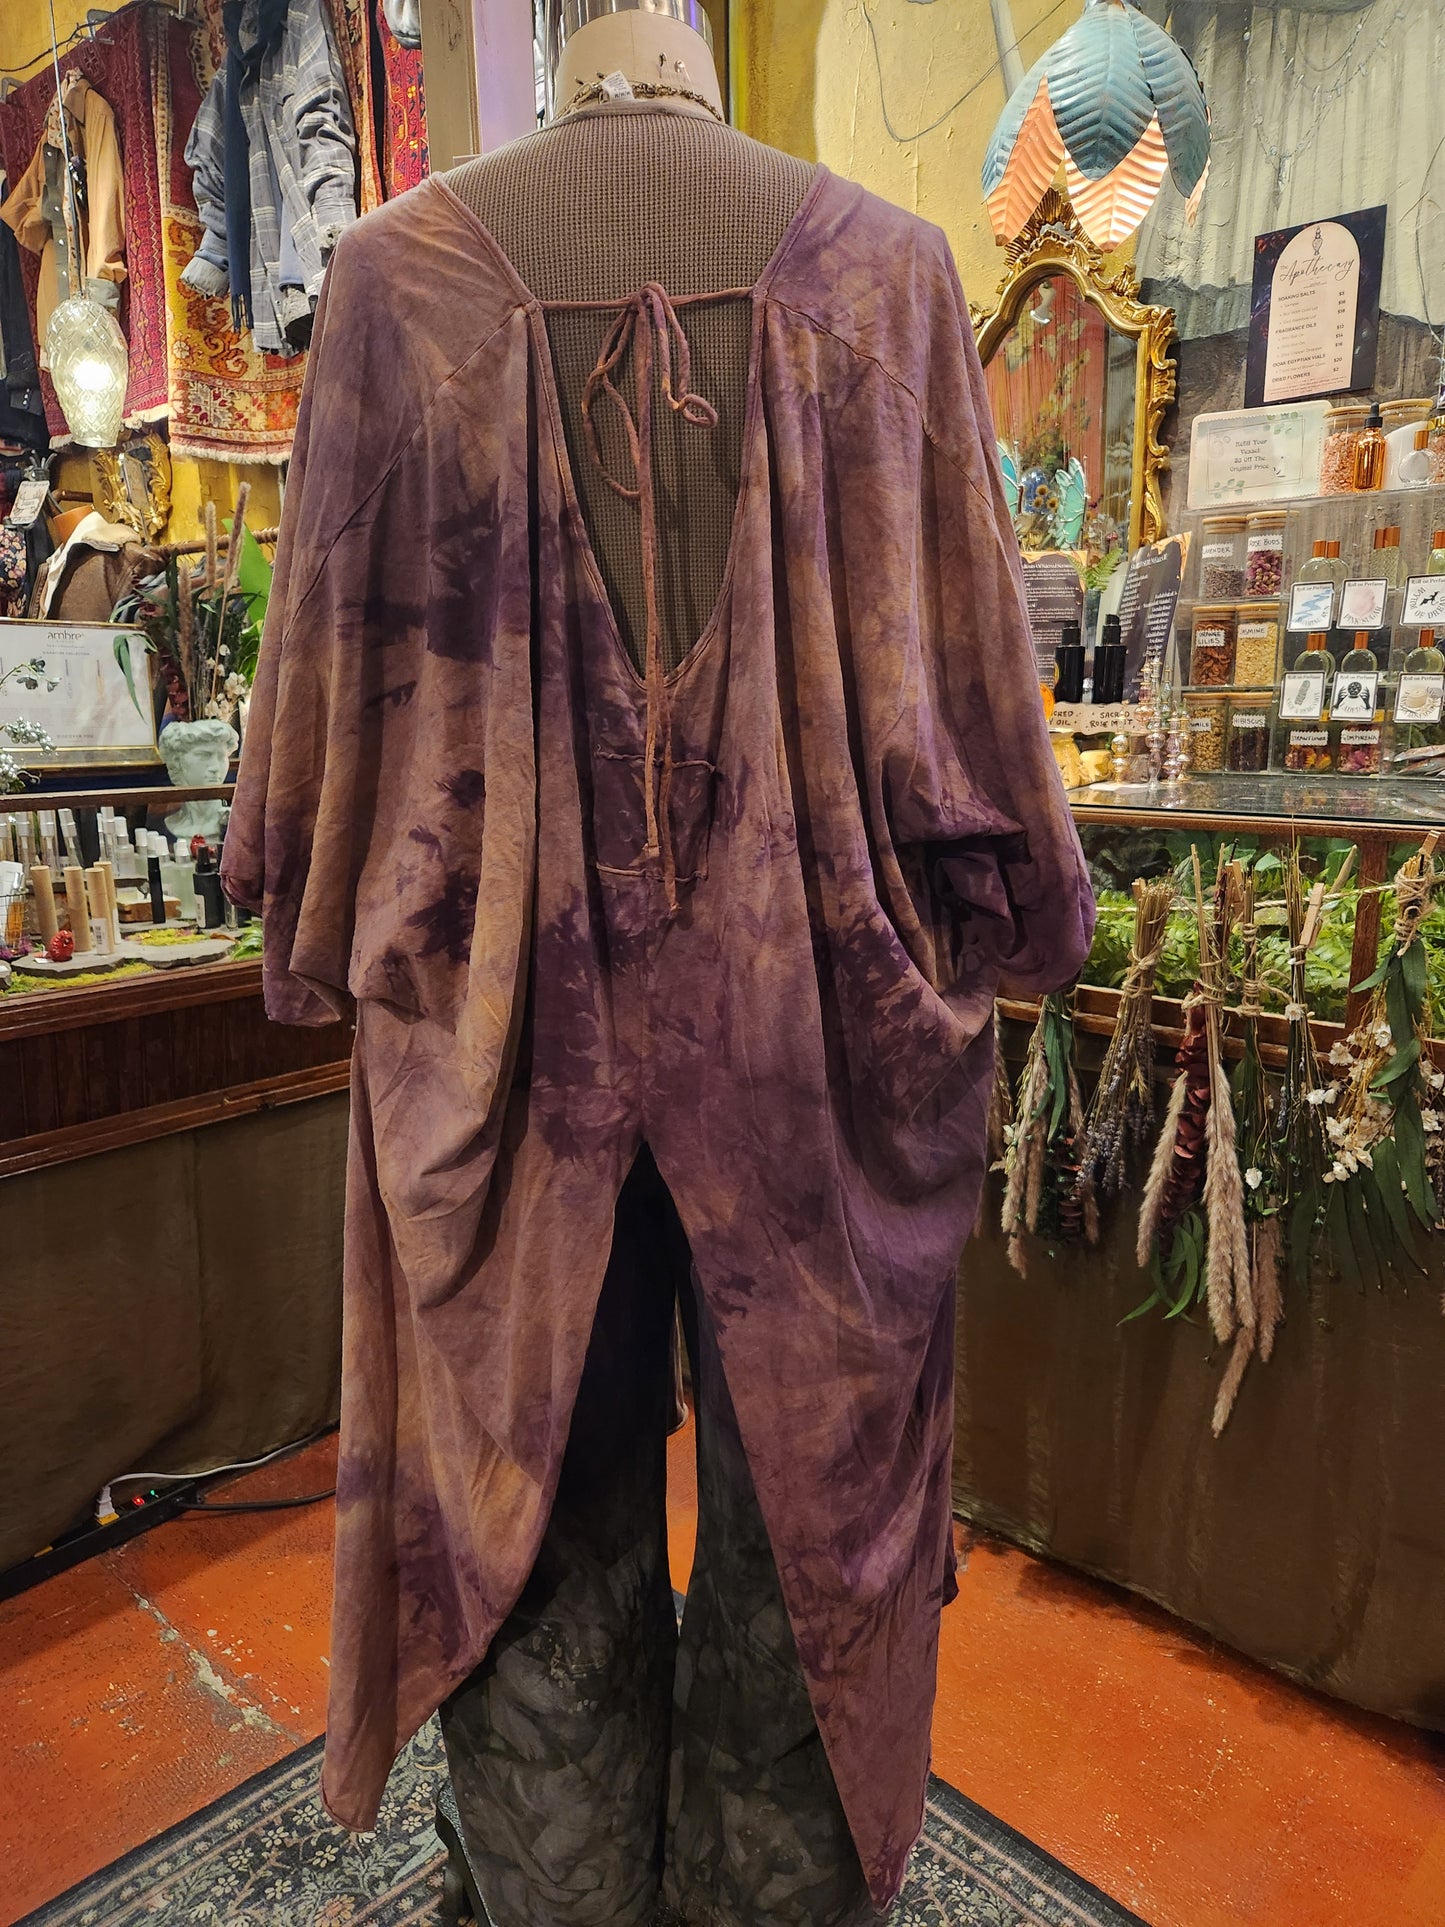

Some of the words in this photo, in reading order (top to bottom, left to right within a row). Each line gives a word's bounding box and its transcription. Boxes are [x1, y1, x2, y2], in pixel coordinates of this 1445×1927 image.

[1280, 256, 1355, 287] Apothecary
[1278, 294, 1299, 302] SOAKING
[1300, 290, 1316, 298] SALTS
[1275, 324, 1305, 334] FRAGRANCE
[1287, 356, 1311, 365] EGYPTIAN
[1287, 372, 1311, 380] FLOWERS
[1235, 440, 1251, 448] Refill
[1263, 538, 1280, 546] BUDS
[47, 630, 82, 641] ambre
[1100, 711, 1130, 719] SACRD
[1089, 720, 1109, 728] ROSE
[1233, 717, 1264, 725] HIBISCUS
